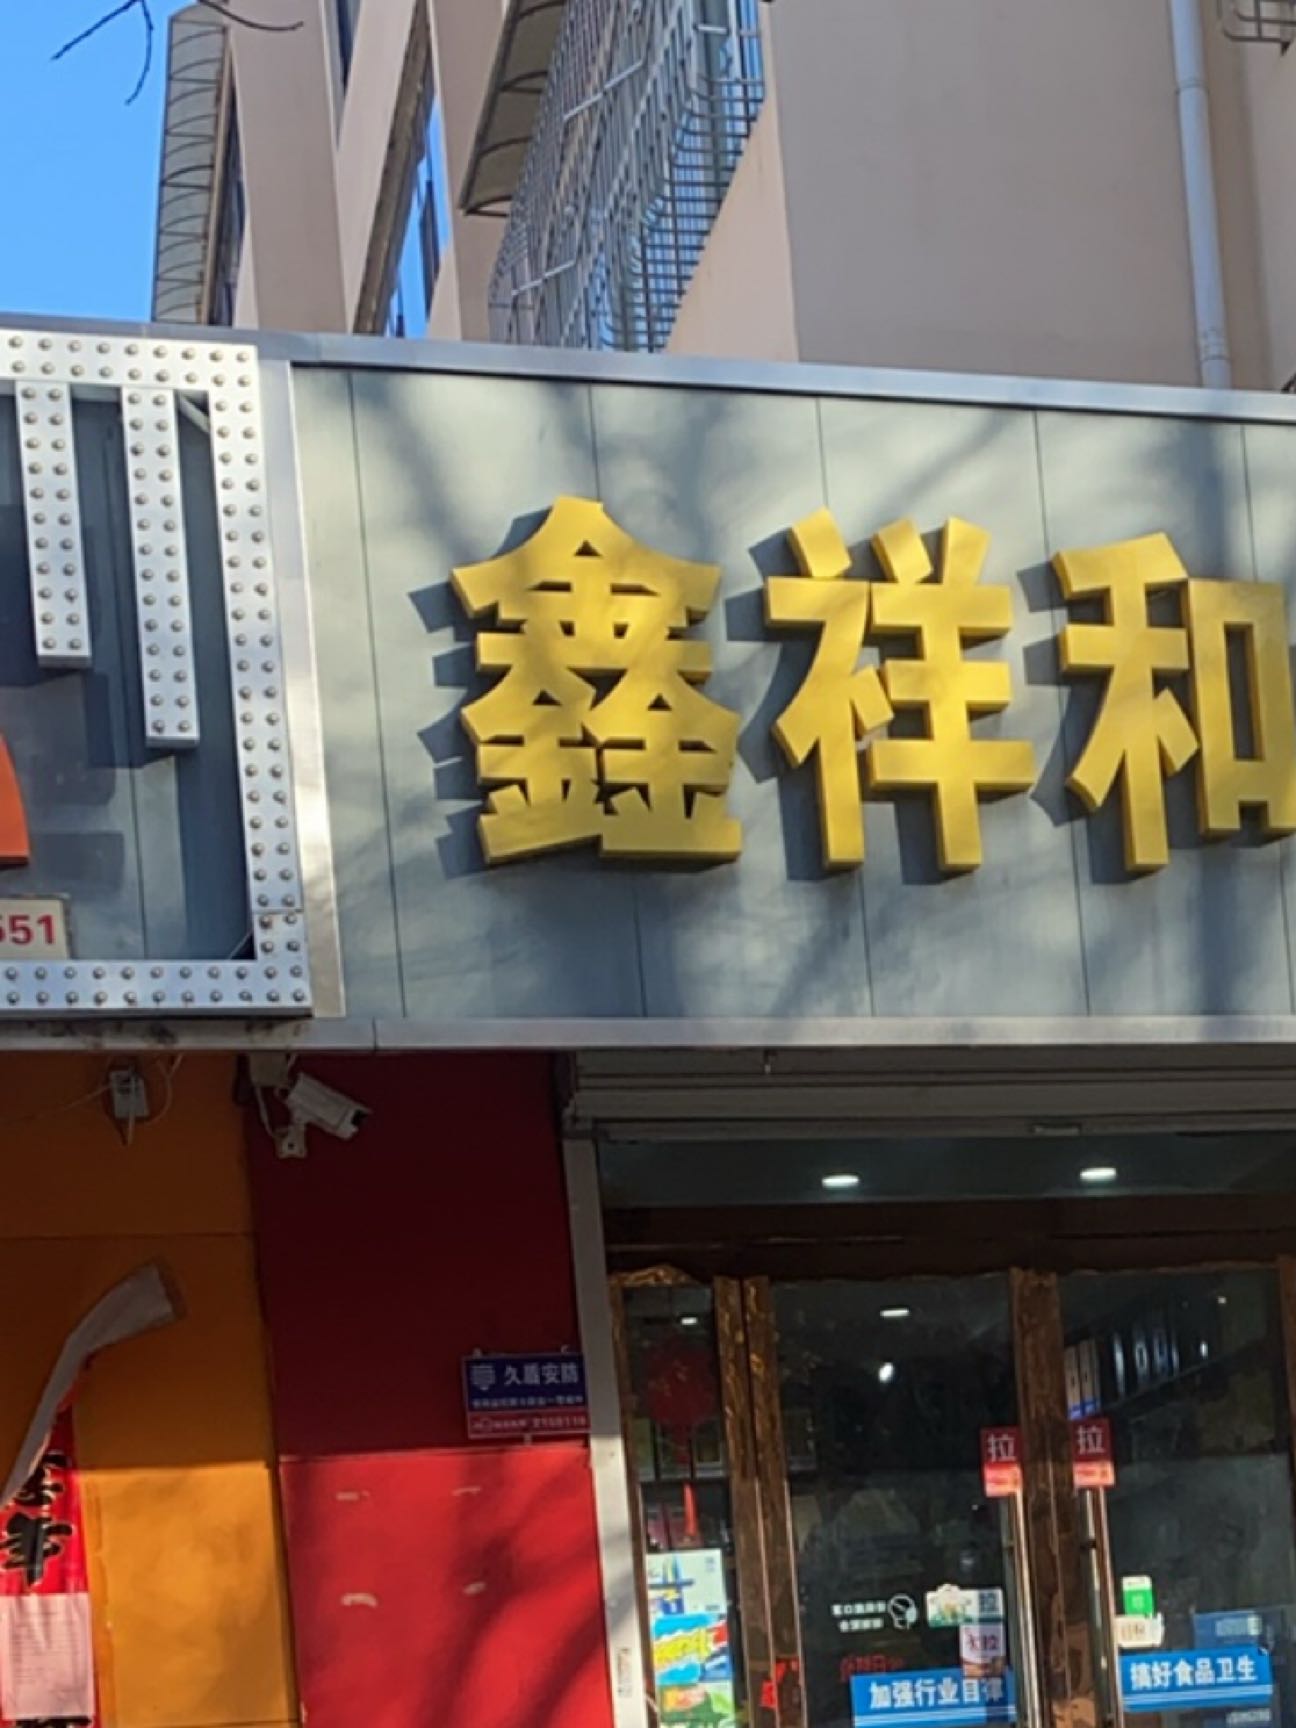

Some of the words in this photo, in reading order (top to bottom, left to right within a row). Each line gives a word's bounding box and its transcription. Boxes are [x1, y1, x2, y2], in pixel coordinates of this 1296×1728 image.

[0, 914, 54, 946] 51
[987, 1433, 1017, 1463] 拉
[1076, 1425, 1105, 1455] 拉
[1130, 1654, 1257, 1691] 搞好食品卫生
